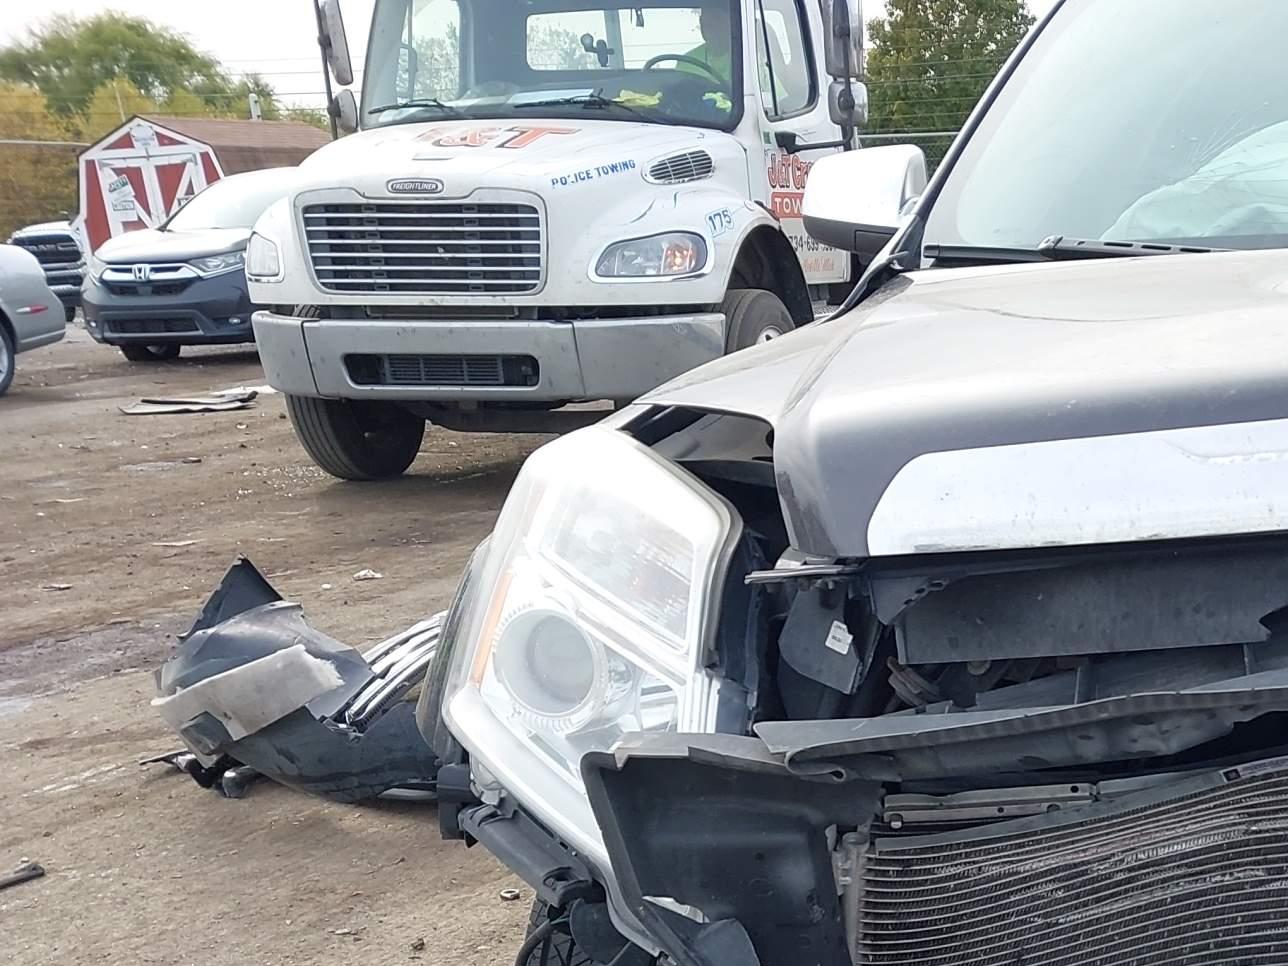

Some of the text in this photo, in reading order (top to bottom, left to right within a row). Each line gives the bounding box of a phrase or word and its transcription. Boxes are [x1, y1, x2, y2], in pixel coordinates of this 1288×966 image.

[551, 159, 636, 189] POLICE TOWING
[391, 181, 438, 191] FREIGHTLINER
[708, 209, 732, 231] 175
